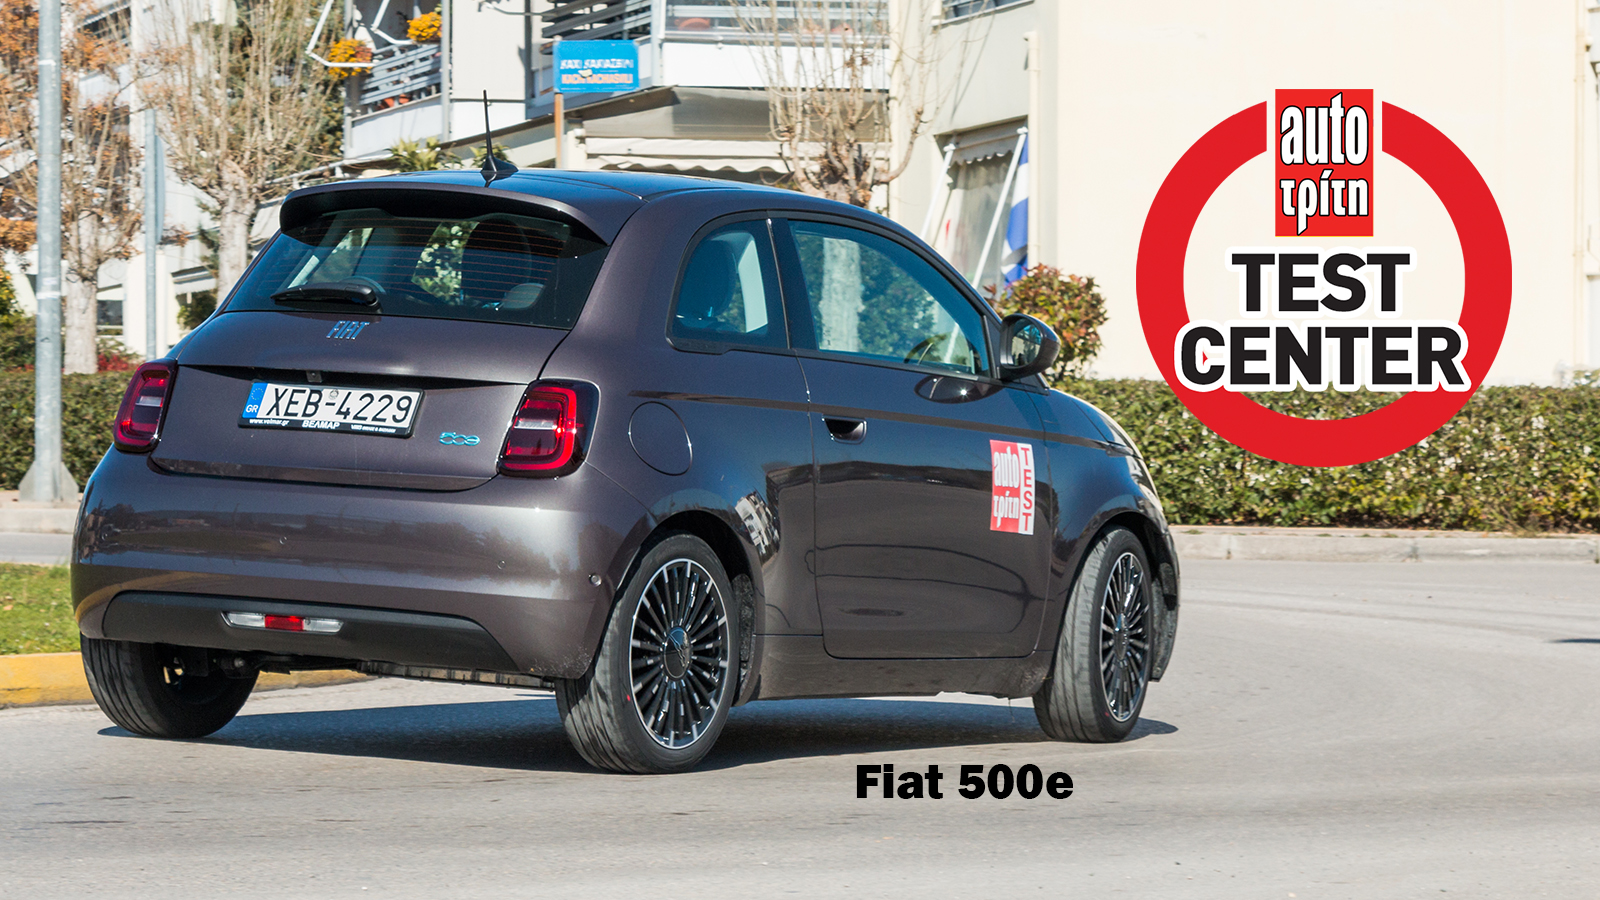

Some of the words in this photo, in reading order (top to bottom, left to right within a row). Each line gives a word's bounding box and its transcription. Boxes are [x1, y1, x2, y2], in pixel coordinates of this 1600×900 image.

[326, 320, 371, 340] FIAT
[245, 404, 259, 413] GR
[993, 445, 1020, 489] auto
[1020, 447, 1033, 532] TEST
[993, 490, 1020, 529] τρίτη
